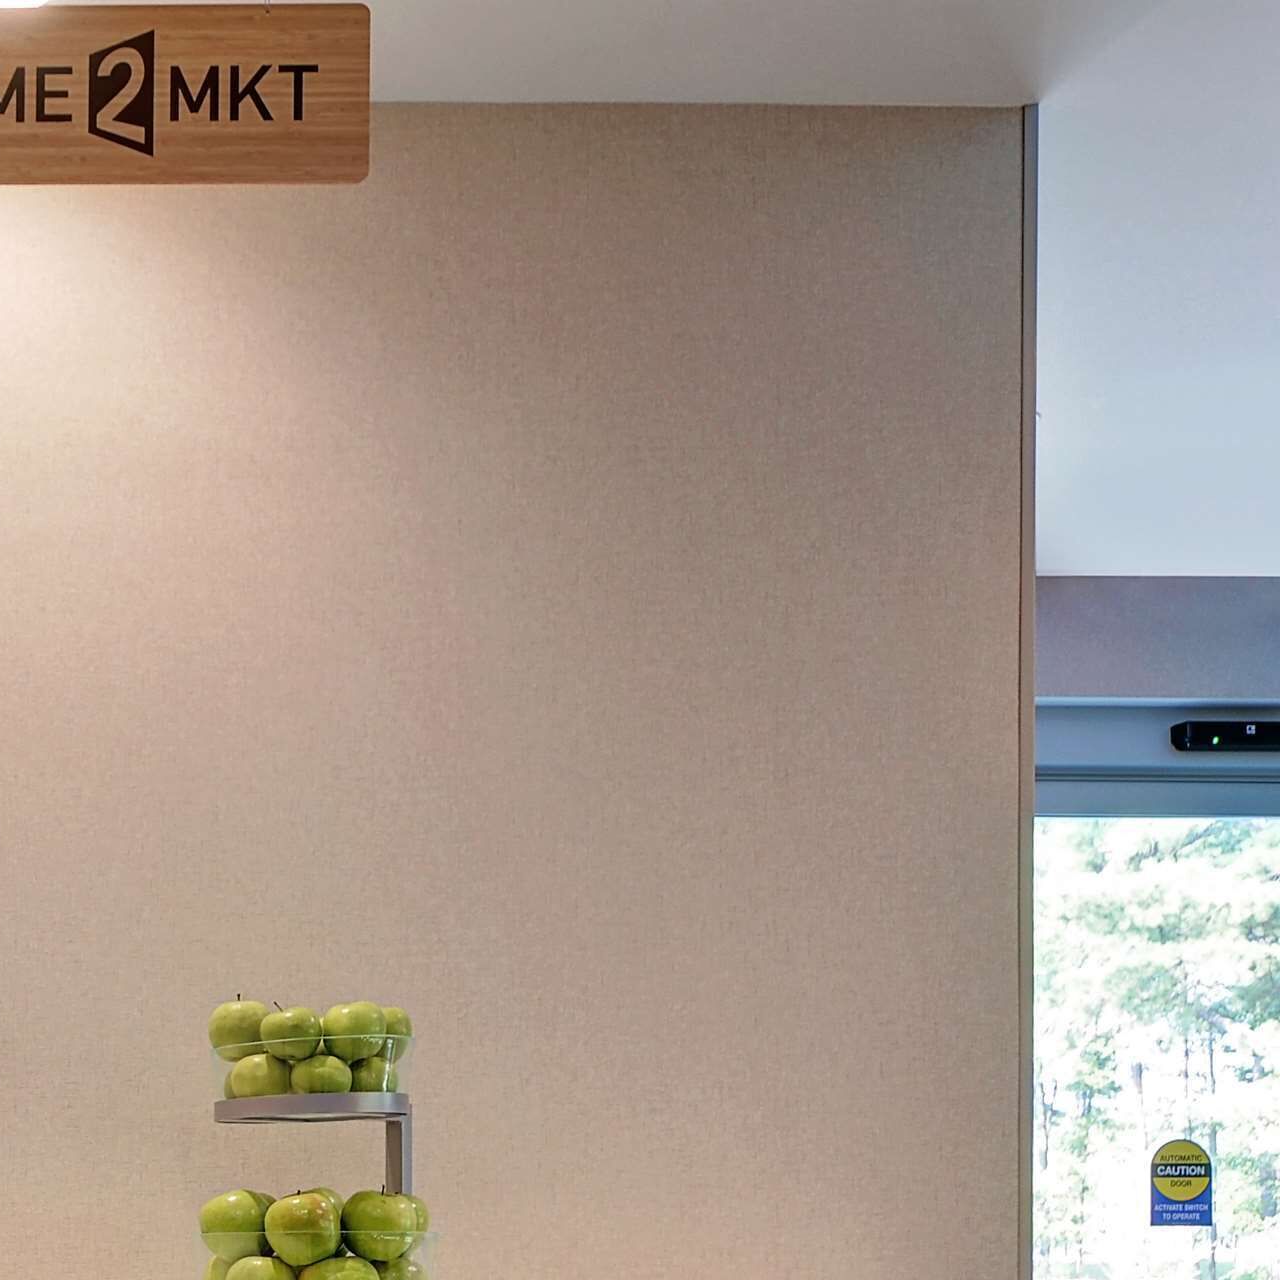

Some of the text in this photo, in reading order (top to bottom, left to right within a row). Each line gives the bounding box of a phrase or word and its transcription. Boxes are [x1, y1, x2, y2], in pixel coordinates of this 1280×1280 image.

[1159, 1154, 1202, 1162] AUTOMATIC
[1157, 1165, 1205, 1176] CAUTION
[1154, 1203, 1209, 1211] ACTIVATE SWITCH
